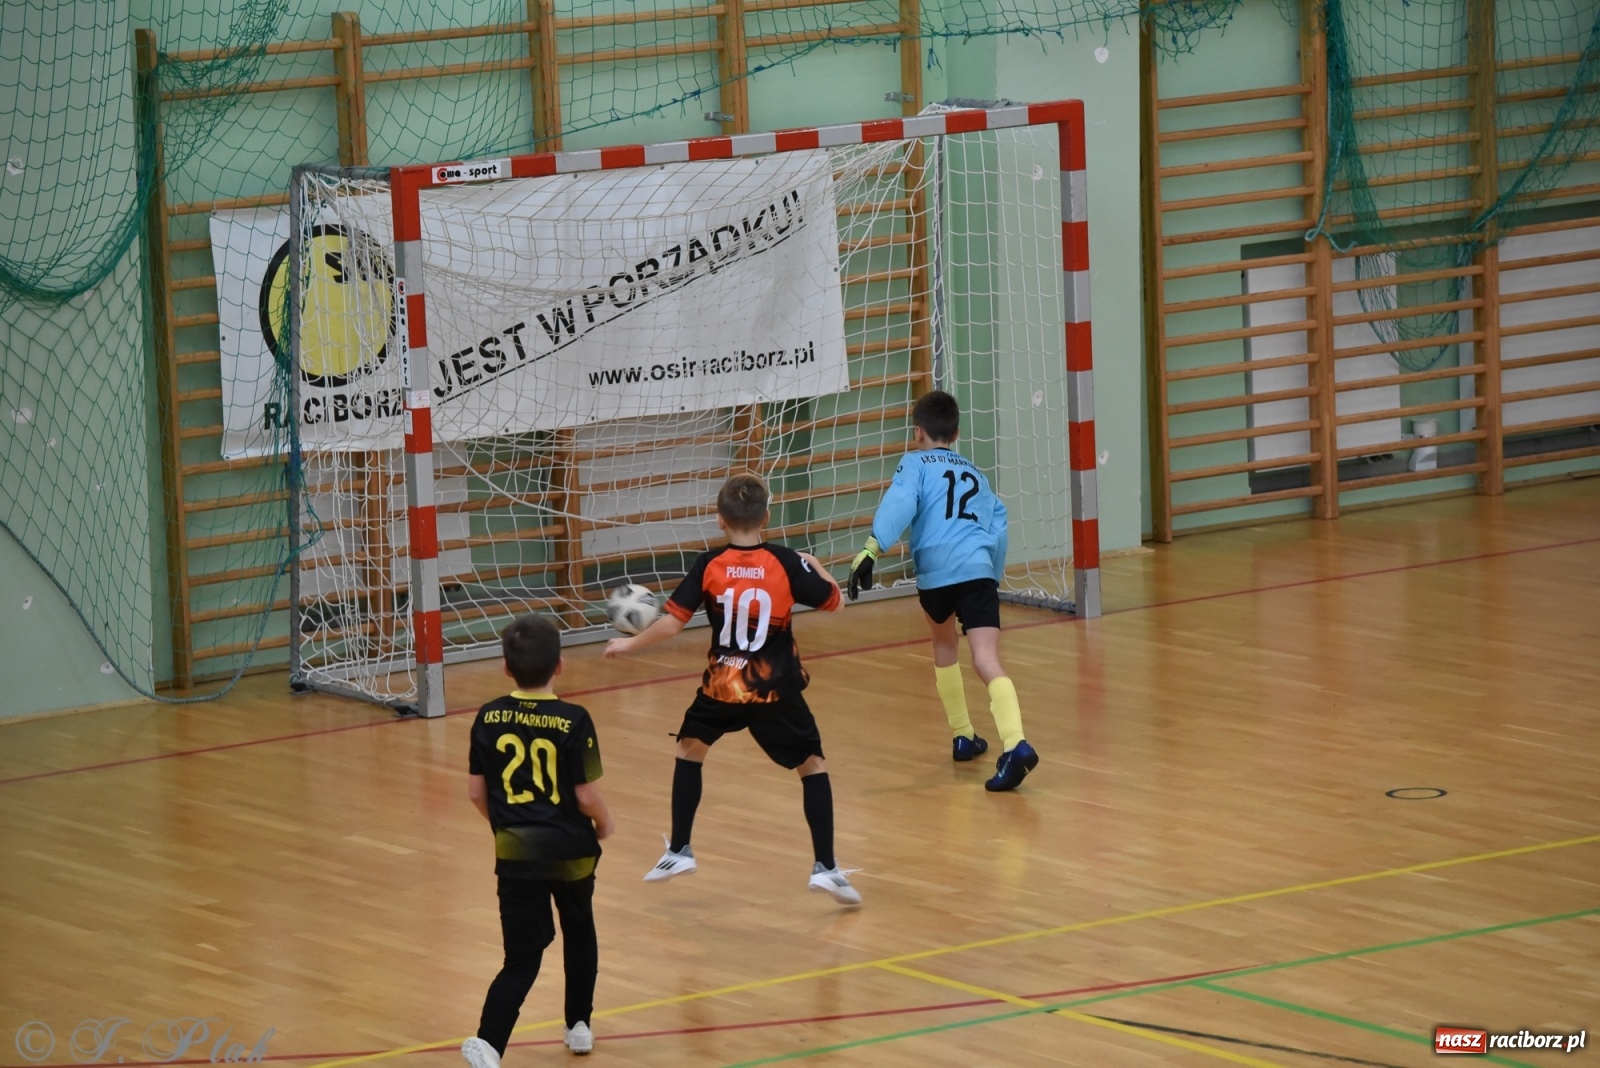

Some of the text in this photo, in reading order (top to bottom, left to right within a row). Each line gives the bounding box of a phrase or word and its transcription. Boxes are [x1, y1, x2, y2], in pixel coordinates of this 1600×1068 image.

[433, 322, 526, 397] JEST
[536, 299, 576, 345] W
[942, 470, 979, 522] 12
[726, 566, 765, 580] PŁOMIEŃ
[716, 588, 772, 653] 10
[502, 710, 513, 723] 07
[515, 711, 572, 733] MARKOWICE
[496, 733, 561, 805] 20
